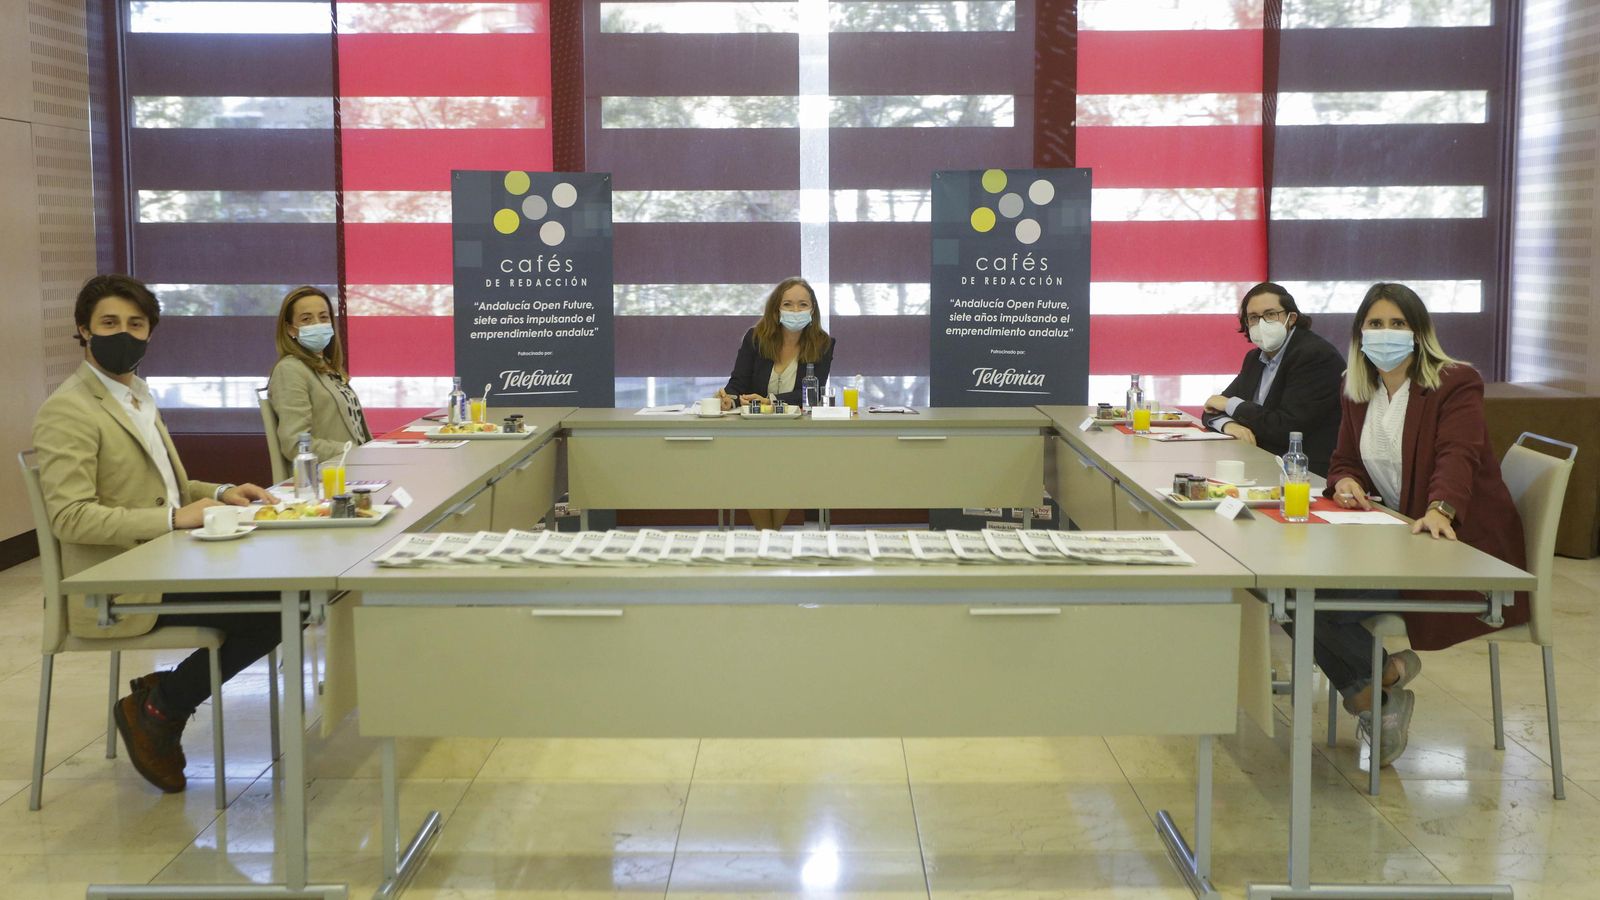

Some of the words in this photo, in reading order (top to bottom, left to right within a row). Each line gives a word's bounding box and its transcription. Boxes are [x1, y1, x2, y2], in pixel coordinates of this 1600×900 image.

[500, 254, 573, 273] cafés
[976, 252, 1048, 271] cafés
[486, 278, 500, 288] DE
[510, 276, 587, 287] REDACCIÓN
[961, 276, 975, 285] DE
[984, 274, 1062, 286] REDACCIÓN
[532, 300, 561, 312] Open
[1006, 299, 1034, 310] Open
[473, 315, 498, 325] siete
[500, 314, 524, 324] años
[526, 314, 584, 326] impulsando
[586, 314, 596, 323] el
[949, 312, 972, 322] siete
[974, 312, 998, 322] años
[1000, 312, 1058, 324] impulsando
[1060, 314, 1070, 324] el
[470, 328, 553, 341] emprendimiento
[946, 326, 1026, 337] emprendimiento
